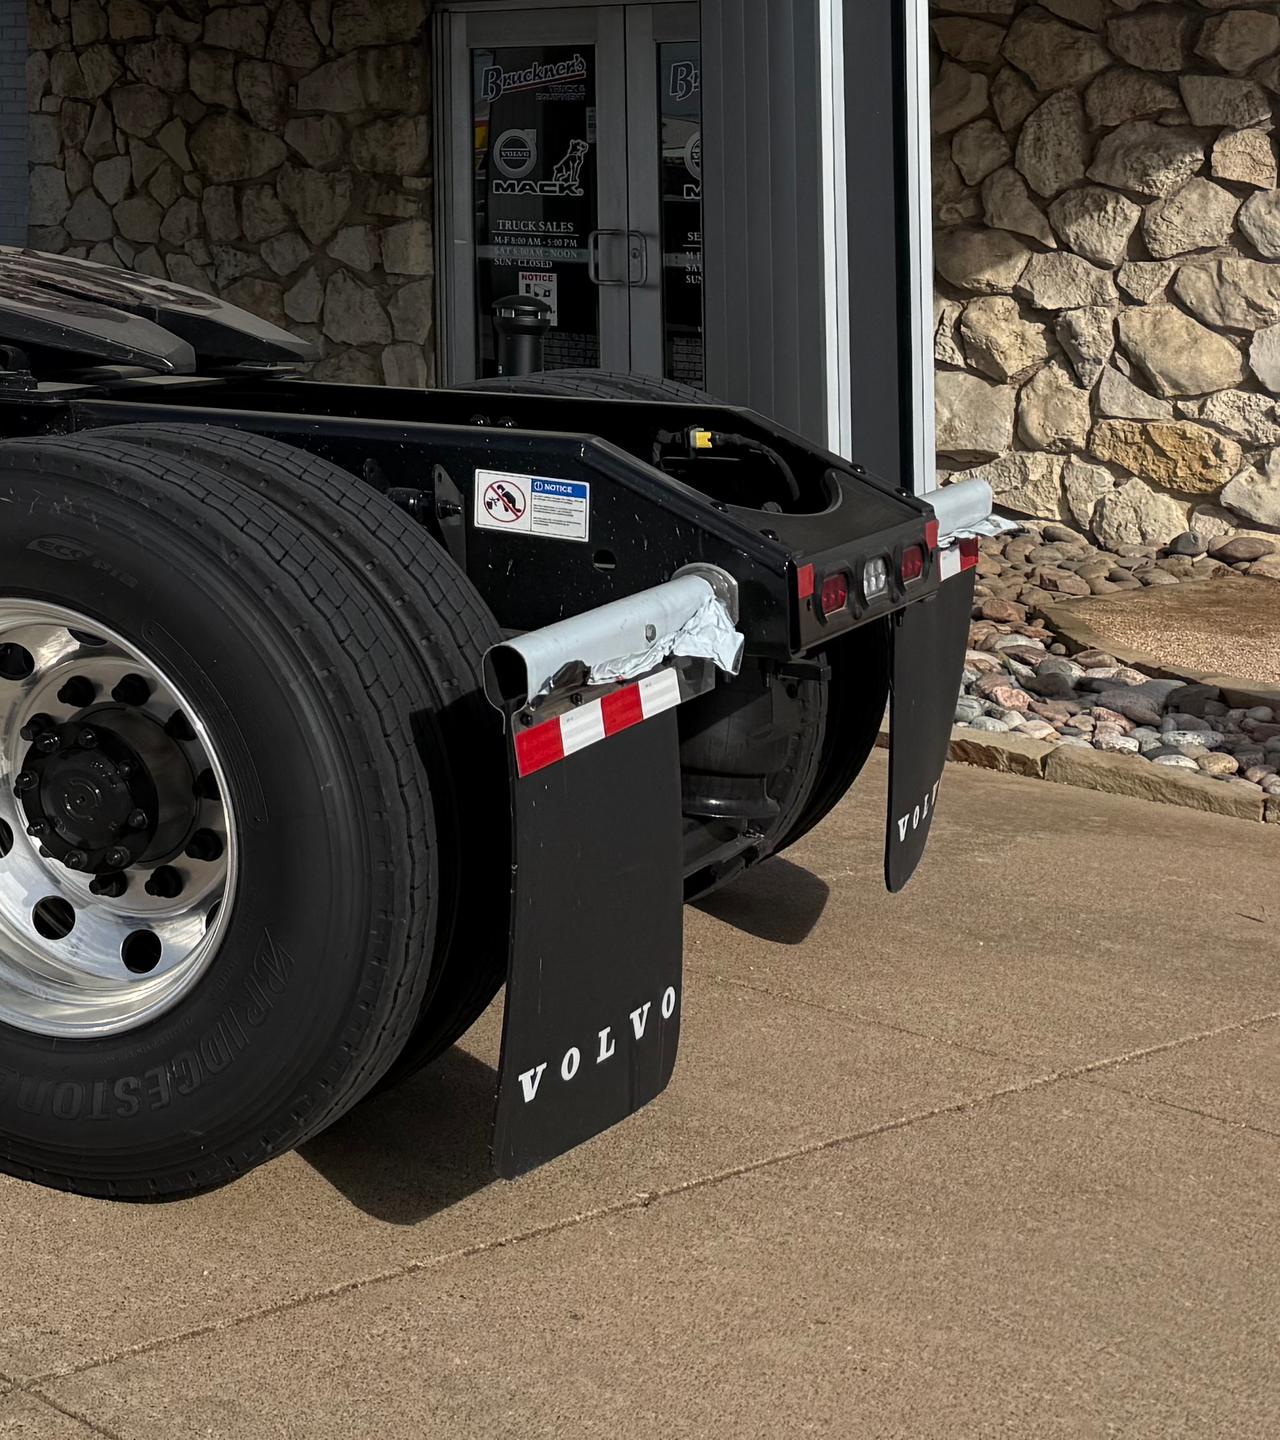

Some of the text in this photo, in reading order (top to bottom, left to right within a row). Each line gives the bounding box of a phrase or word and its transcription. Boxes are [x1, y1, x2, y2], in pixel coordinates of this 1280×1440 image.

[481, 53, 587, 103] Bruckner's
[493, 179, 581, 196] MACK
[496, 219, 574, 233] TRUCK SALES
[527, 237, 542, 246] AM
[547, 238, 562, 247] 5:00
[563, 239, 577, 248] PM
[550, 249, 577, 259] NOON
[494, 258, 512, 266] SUN
[518, 259, 553, 268] CLOSED
[521, 273, 554, 282] NOTICE
[544, 483, 573, 494] NOTICE
[517, 985, 677, 1104] VOLVO
